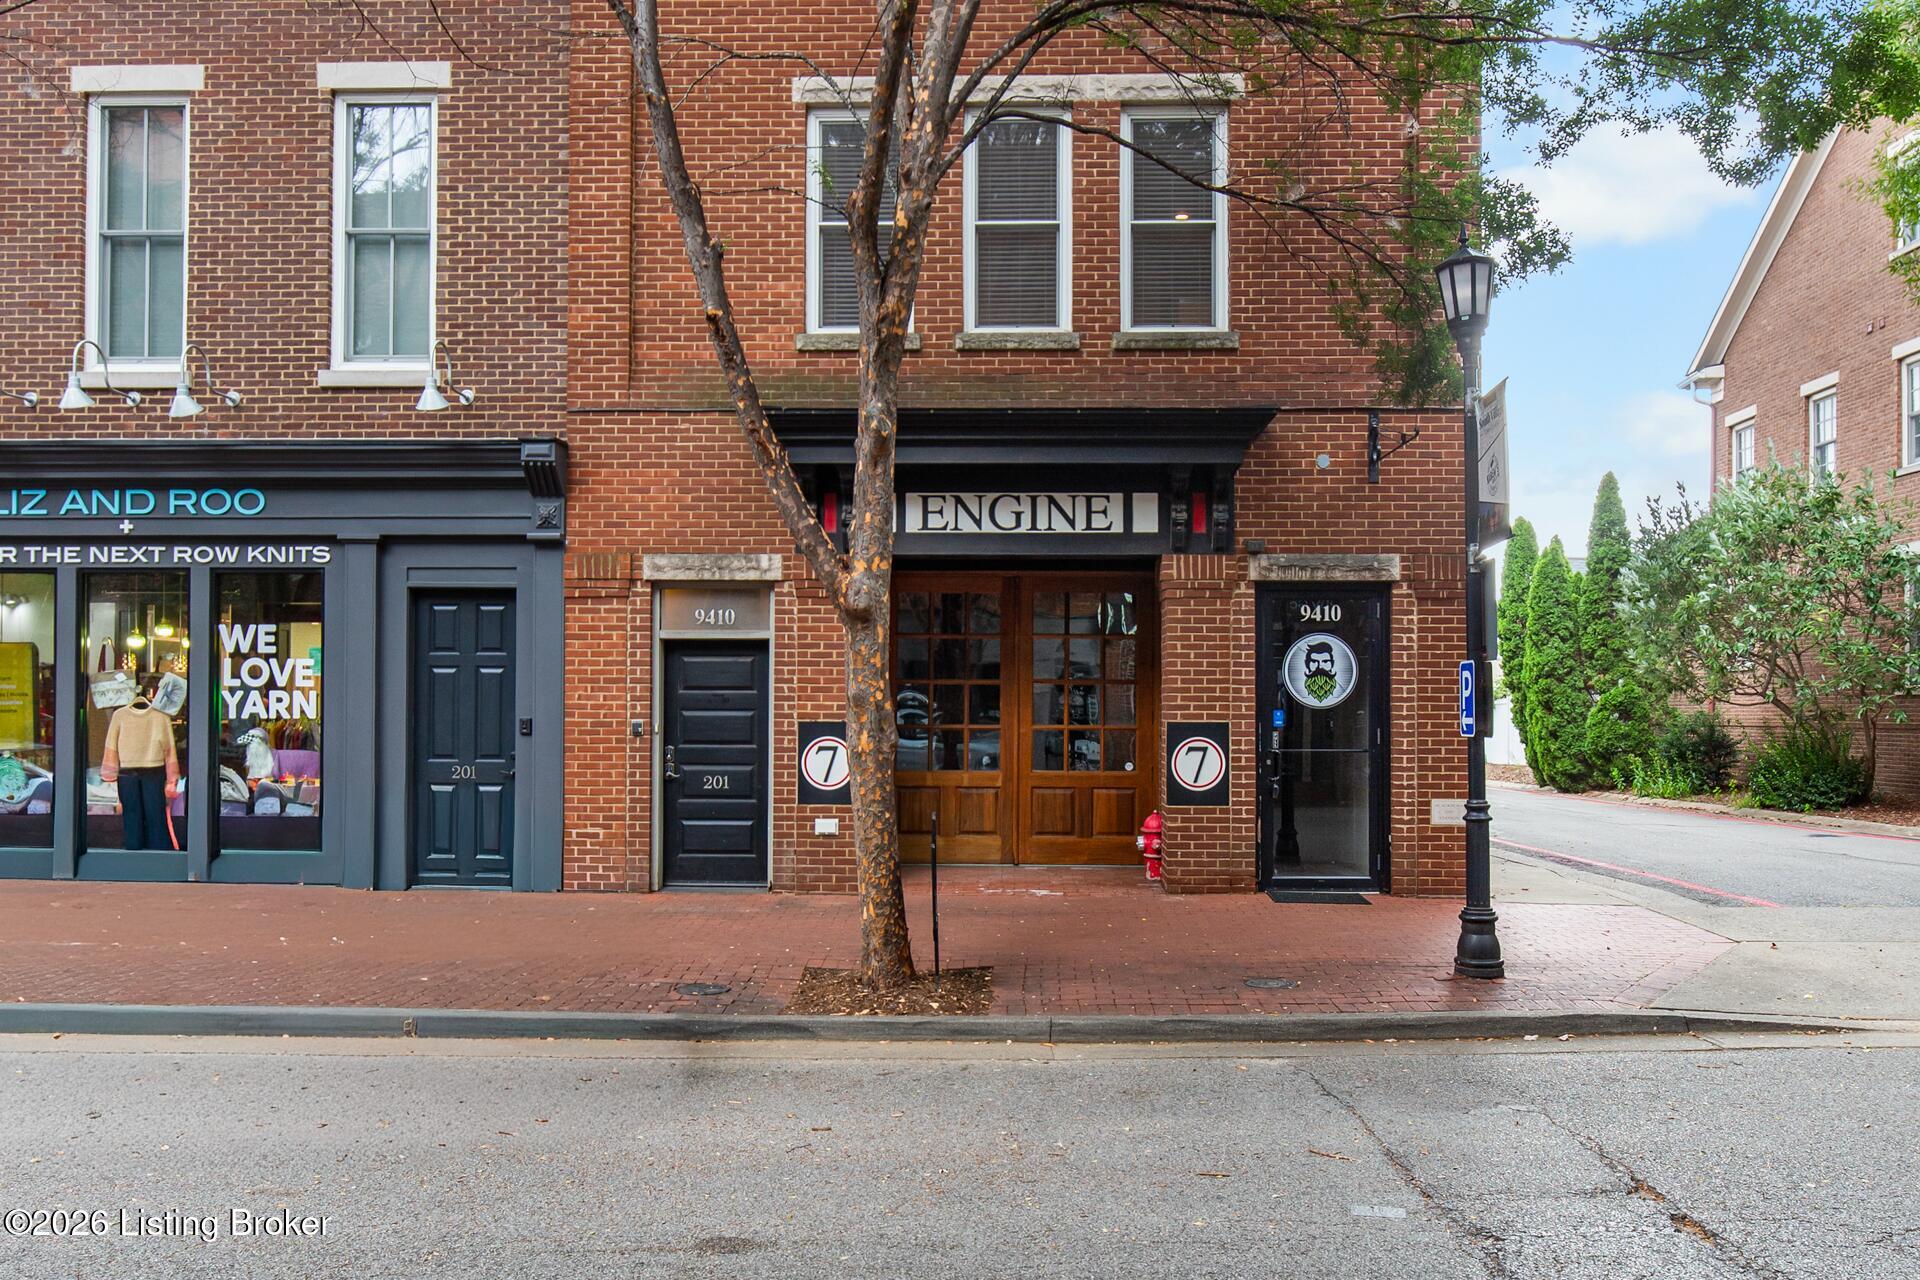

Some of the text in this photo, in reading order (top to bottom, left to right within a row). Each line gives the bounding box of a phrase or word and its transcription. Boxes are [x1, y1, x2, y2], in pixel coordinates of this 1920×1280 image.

[60, 490, 156, 515] AND
[169, 488, 266, 515] ROO
[917, 494, 1113, 532] ENGINE
[23, 546, 81, 564] THE
[89, 546, 166, 564] NEXT
[172, 546, 240, 564] ROW
[247, 546, 332, 564] KNITS
[694, 608, 736, 625] 9410
[1300, 604, 1342, 622] 9410
[218, 624, 277, 653] WE
[223, 657, 315, 687] LOVE
[221, 690, 317, 719] YARN
[1462, 671, 1472, 710] P
[451, 765, 476, 779] 201
[816, 746, 838, 783] 7
[1185, 746, 1209, 784] 7
[703, 775, 730, 789] 201
